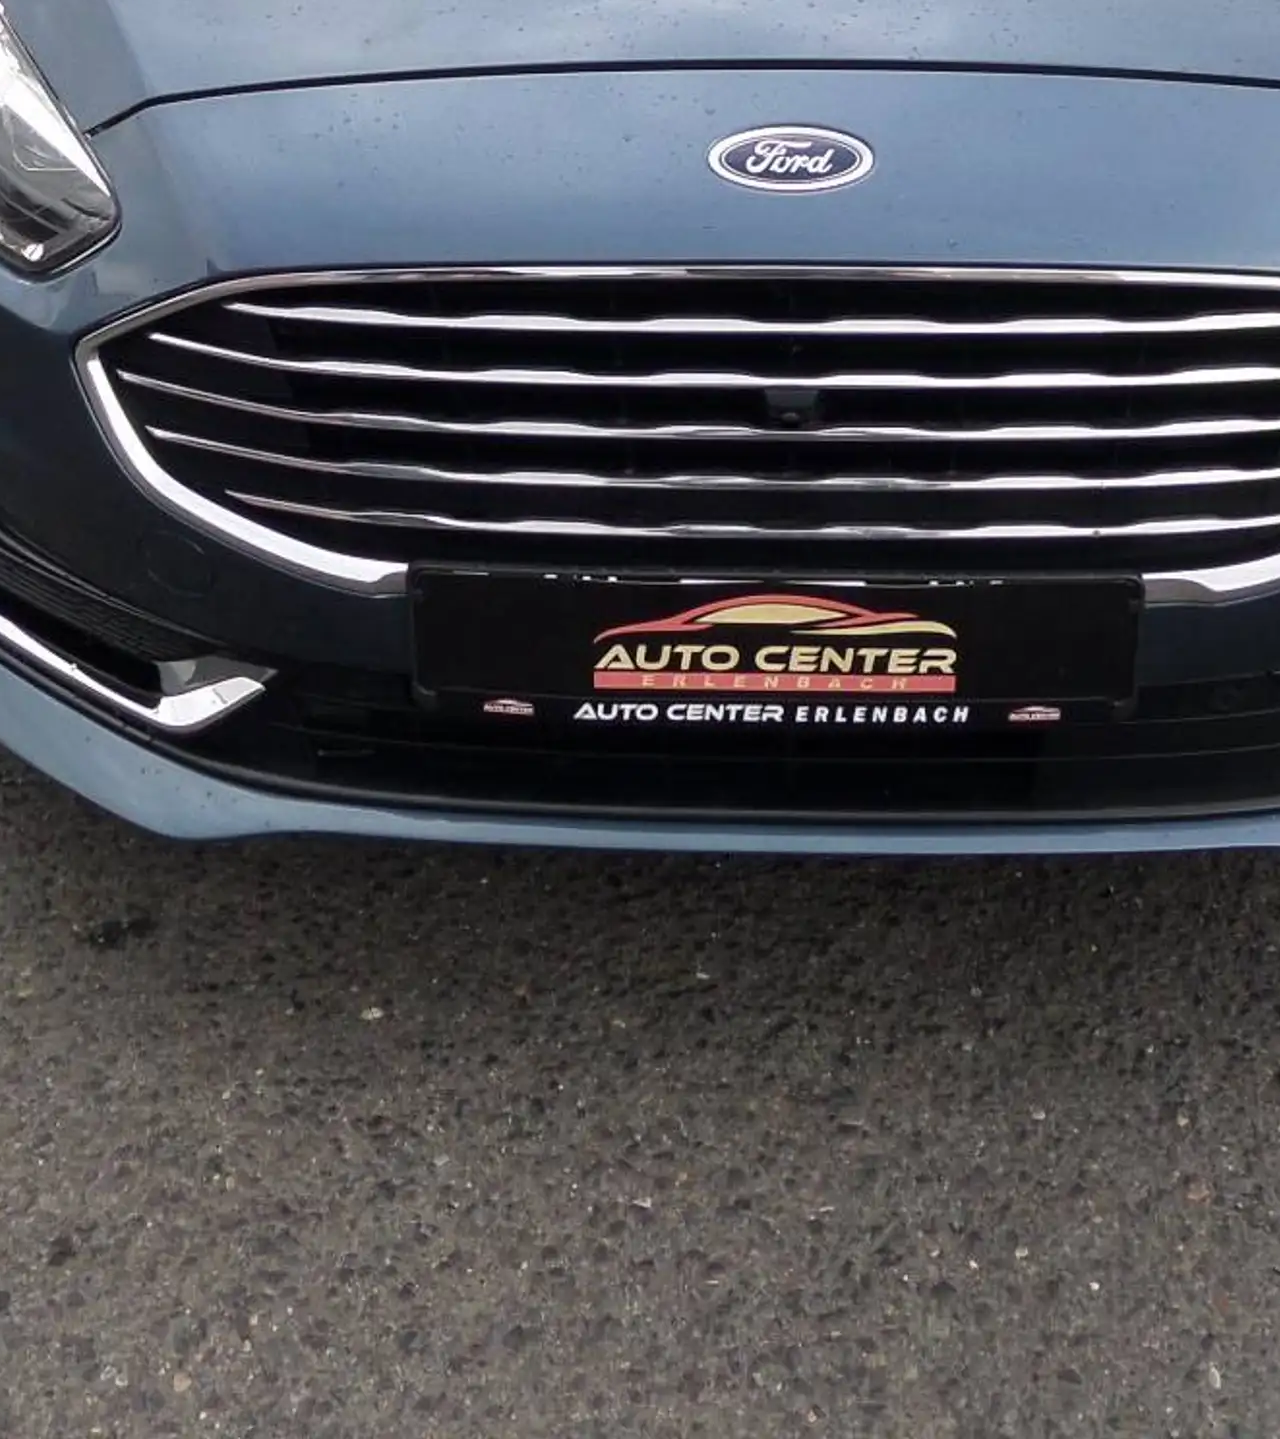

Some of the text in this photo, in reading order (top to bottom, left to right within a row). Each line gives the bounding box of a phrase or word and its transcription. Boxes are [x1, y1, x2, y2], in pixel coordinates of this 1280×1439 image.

[746, 139, 835, 173] Ford
[594, 644, 957, 674] AUTO CENTER
[642, 675, 908, 690] ERLENBACH
[574, 702, 970, 724] AUTO CENTER ERLENBACH
